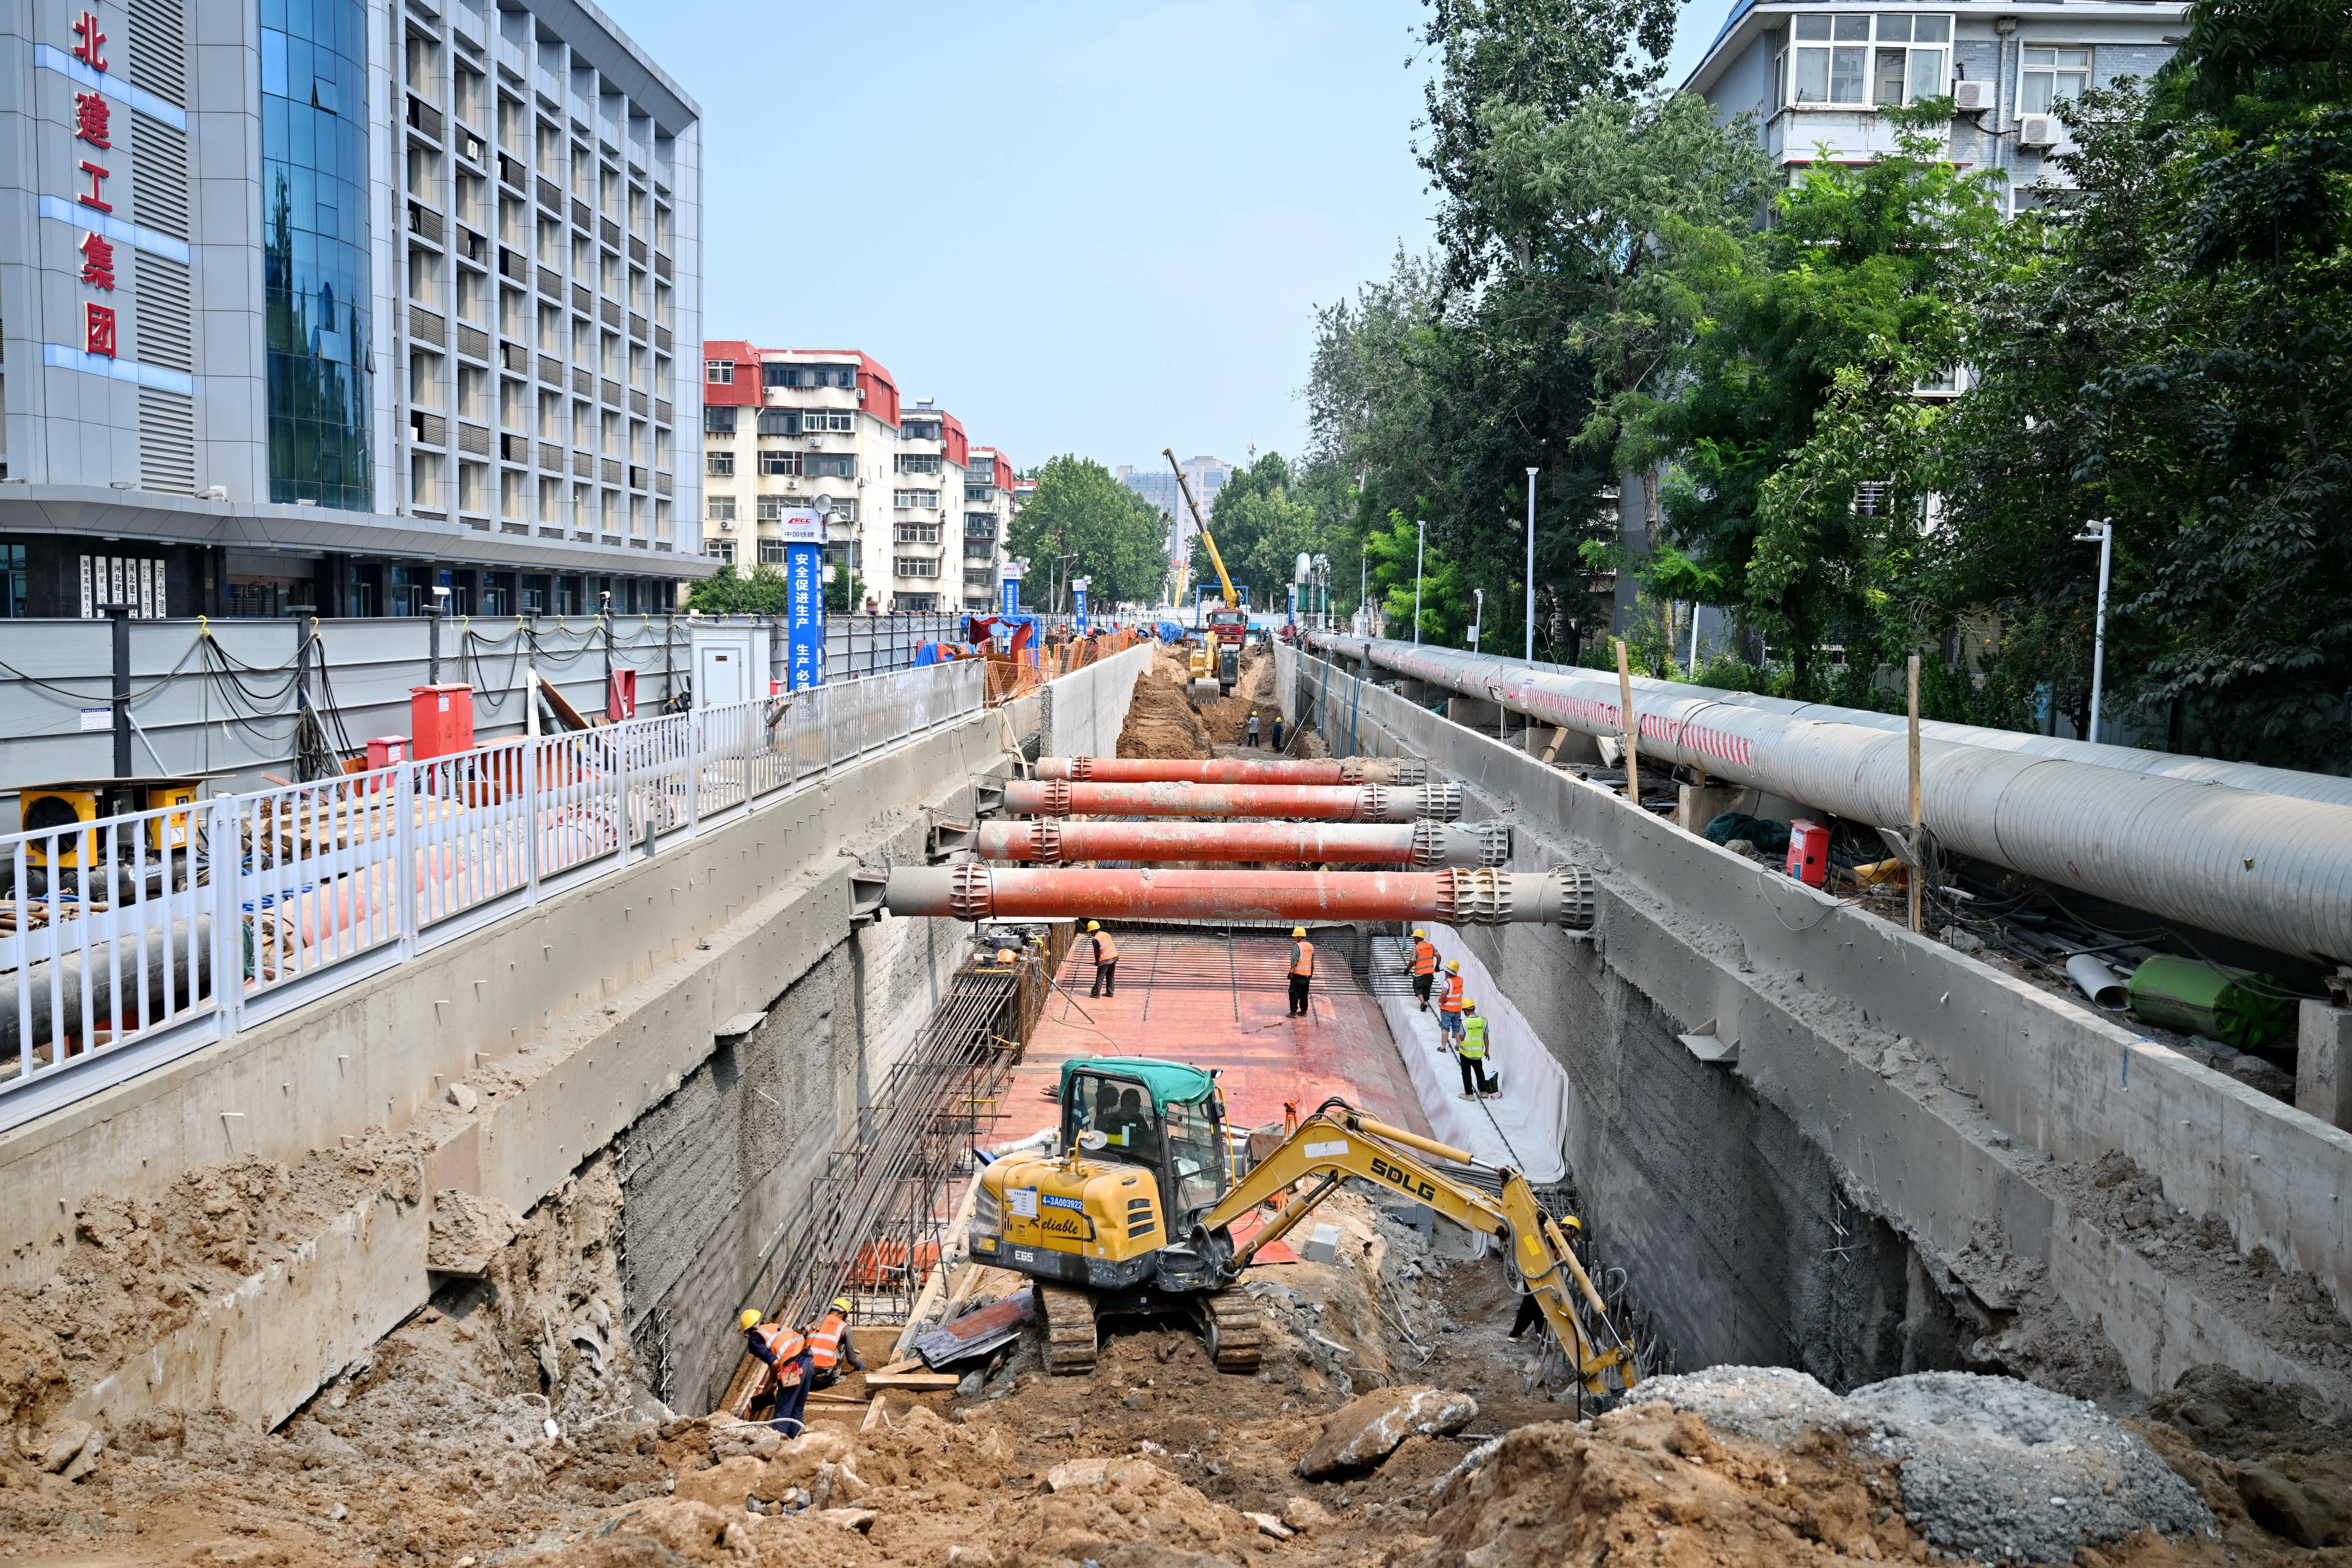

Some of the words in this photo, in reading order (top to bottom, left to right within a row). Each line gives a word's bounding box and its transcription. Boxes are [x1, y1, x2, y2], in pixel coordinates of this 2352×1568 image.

[795, 554, 809, 629] 安全促进生产
[1370, 1157, 1436, 1202] SDLG
[1042, 1196, 1082, 1209] 4-3A003922
[1029, 1213, 1079, 1235] Reliable
